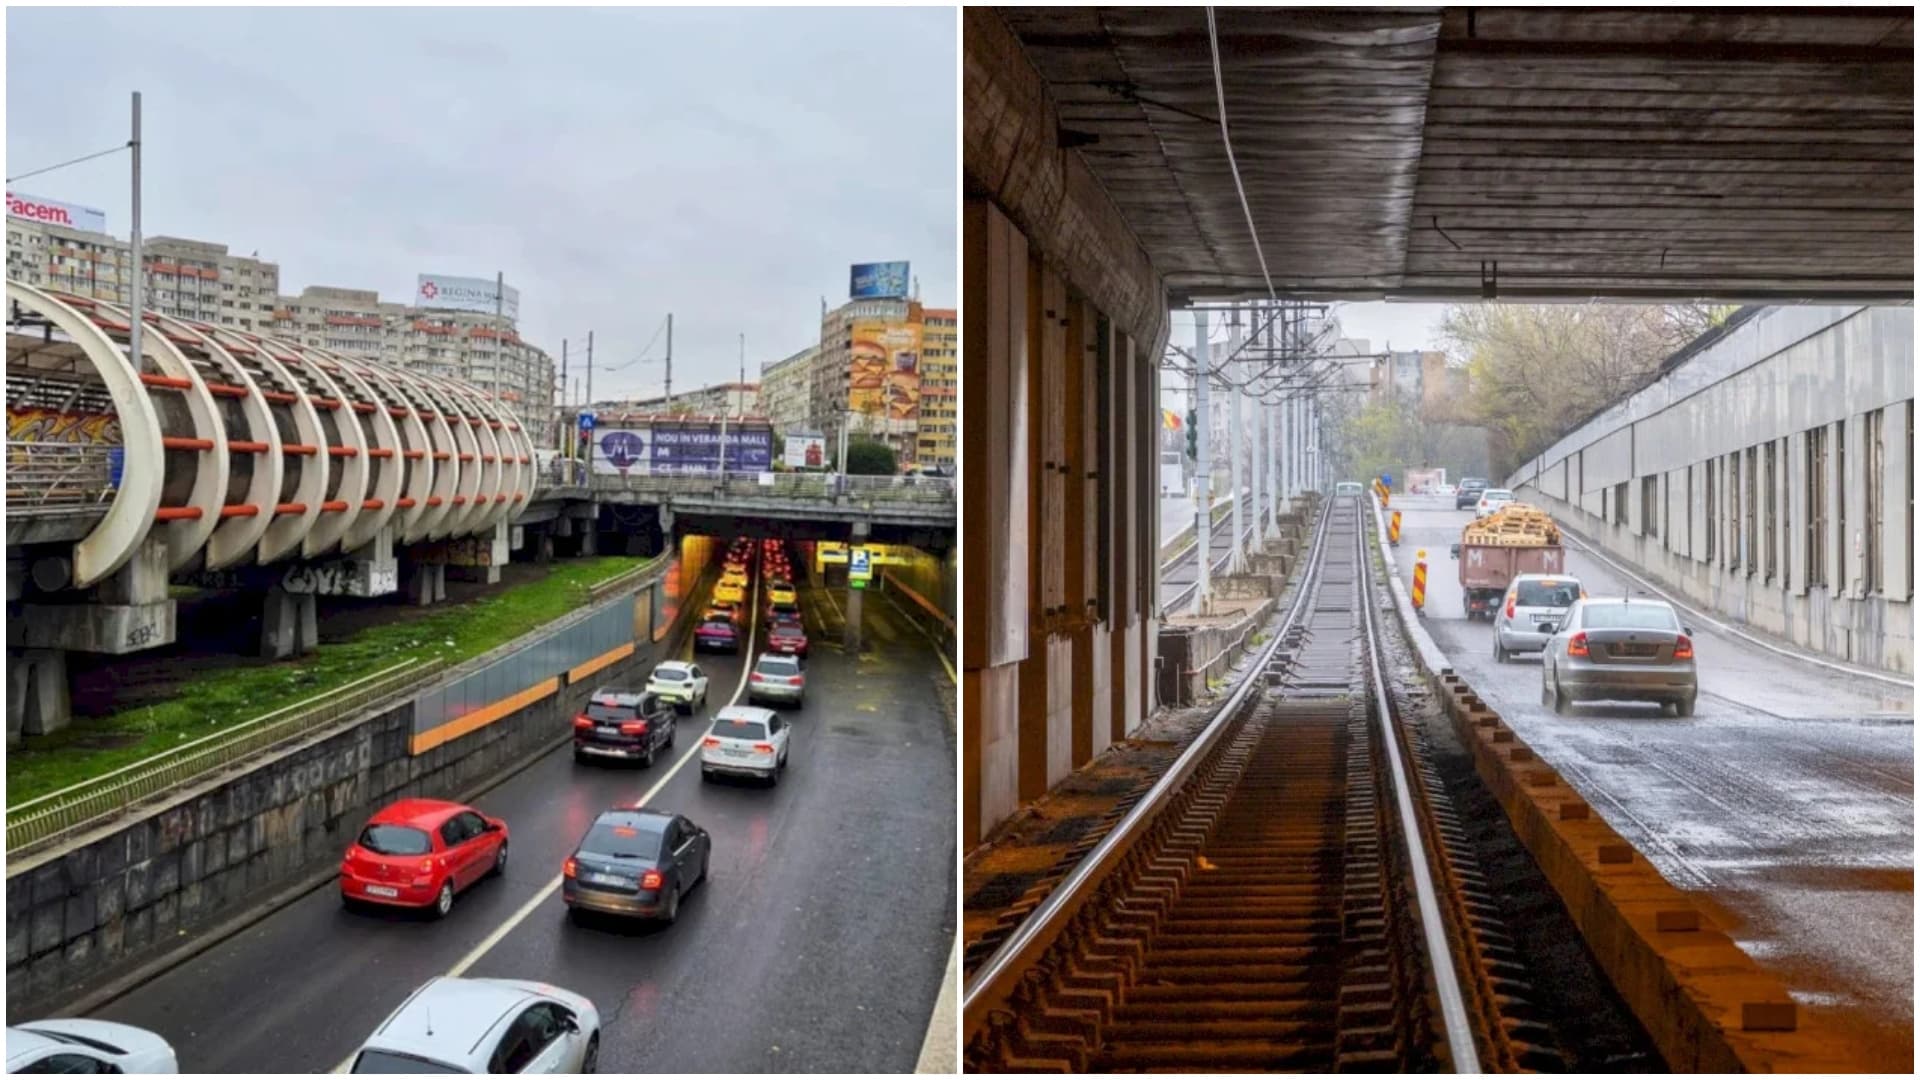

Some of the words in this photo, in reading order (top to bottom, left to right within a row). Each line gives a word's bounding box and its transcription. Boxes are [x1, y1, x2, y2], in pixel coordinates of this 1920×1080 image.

[656, 433, 679, 443] NOU
[741, 435, 767, 446] MALL
[1467, 549, 1483, 568] M
[1543, 550, 1558, 569] M
